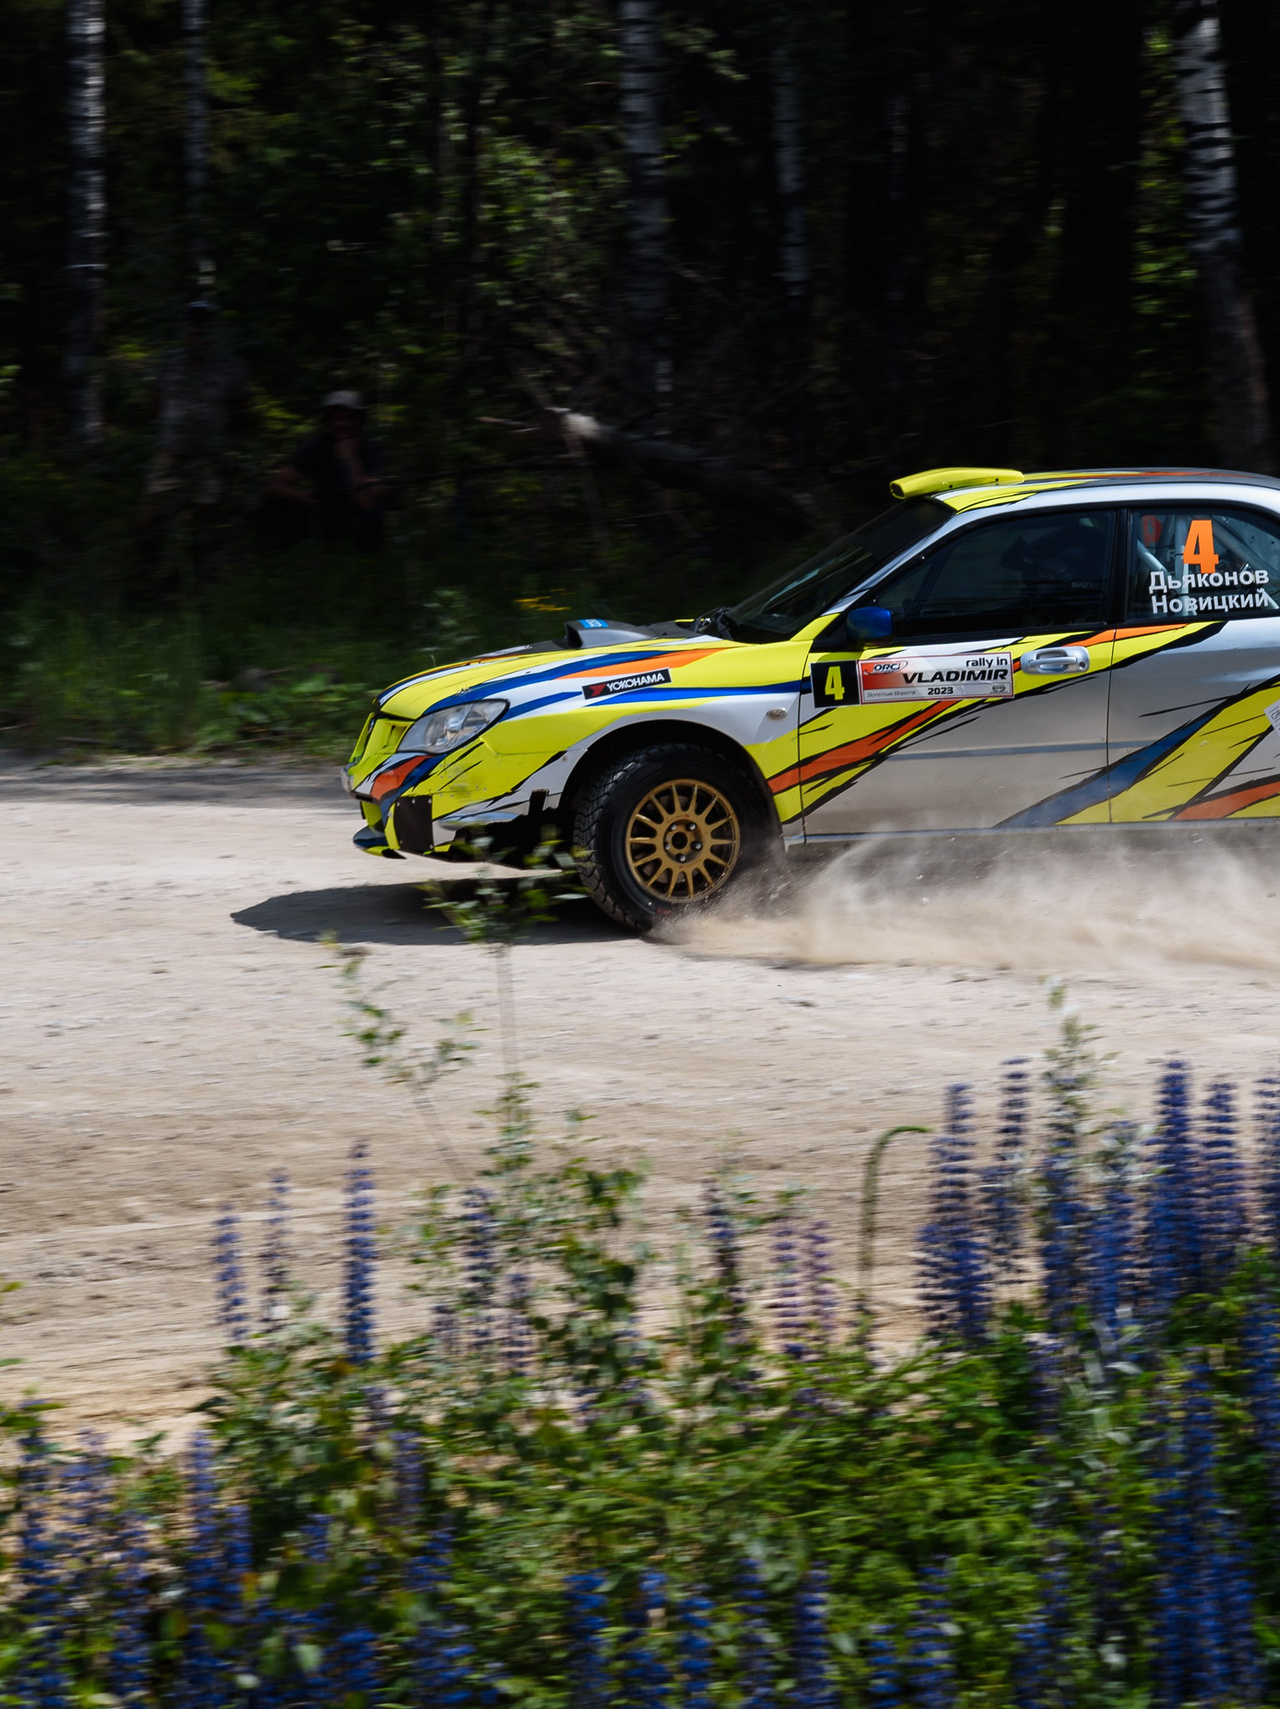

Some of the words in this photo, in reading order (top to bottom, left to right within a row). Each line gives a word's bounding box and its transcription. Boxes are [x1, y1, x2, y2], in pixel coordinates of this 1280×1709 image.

[1183, 519, 1219, 574] 4
[1149, 569, 1270, 594] Дьяконов
[1151, 588, 1270, 614] Новицкий
[965, 658, 994, 668] rally
[996, 657, 1008, 666] in
[606, 673, 665, 692] YOKOHAMA
[824, 666, 845, 700] 4
[902, 669, 1009, 684] VLADIMIR
[927, 687, 954, 696] 2023
